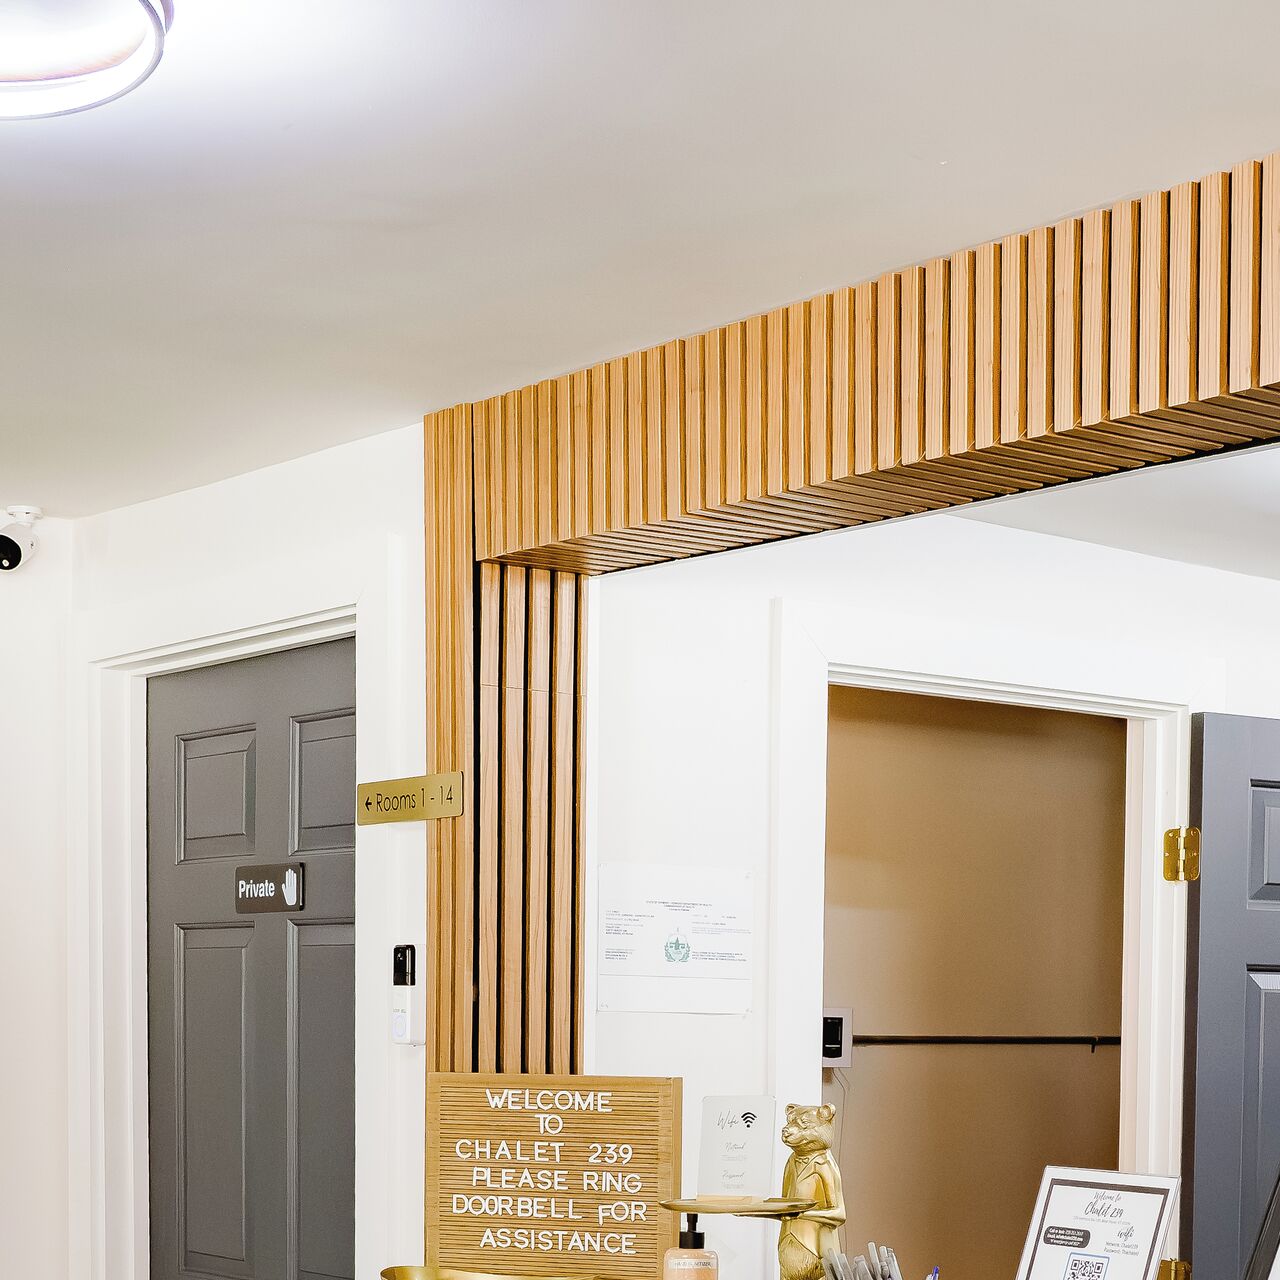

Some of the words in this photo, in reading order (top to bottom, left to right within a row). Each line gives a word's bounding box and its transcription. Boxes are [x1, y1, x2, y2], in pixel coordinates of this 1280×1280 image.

[376, 792, 416, 812] Rooms
[420, 788, 425, 808] 1
[440, 785, 453, 805] 14
[238, 880, 276, 898] Private
[485, 1089, 613, 1112] WELCOME
[534, 1114, 564, 1135] TO
[455, 1139, 565, 1163] CHALET
[588, 1143, 633, 1165] 239
[472, 1167, 569, 1190] PLEASE
[583, 1171, 642, 1194] RING
[452, 1194, 582, 1219] DOORBELL
[598, 1201, 647, 1226] FOR
[1085, 1201, 1110, 1217] Chalet
[1110, 1208, 1124, 1218] 239
[479, 1228, 637, 1255] ASSISTANCE
